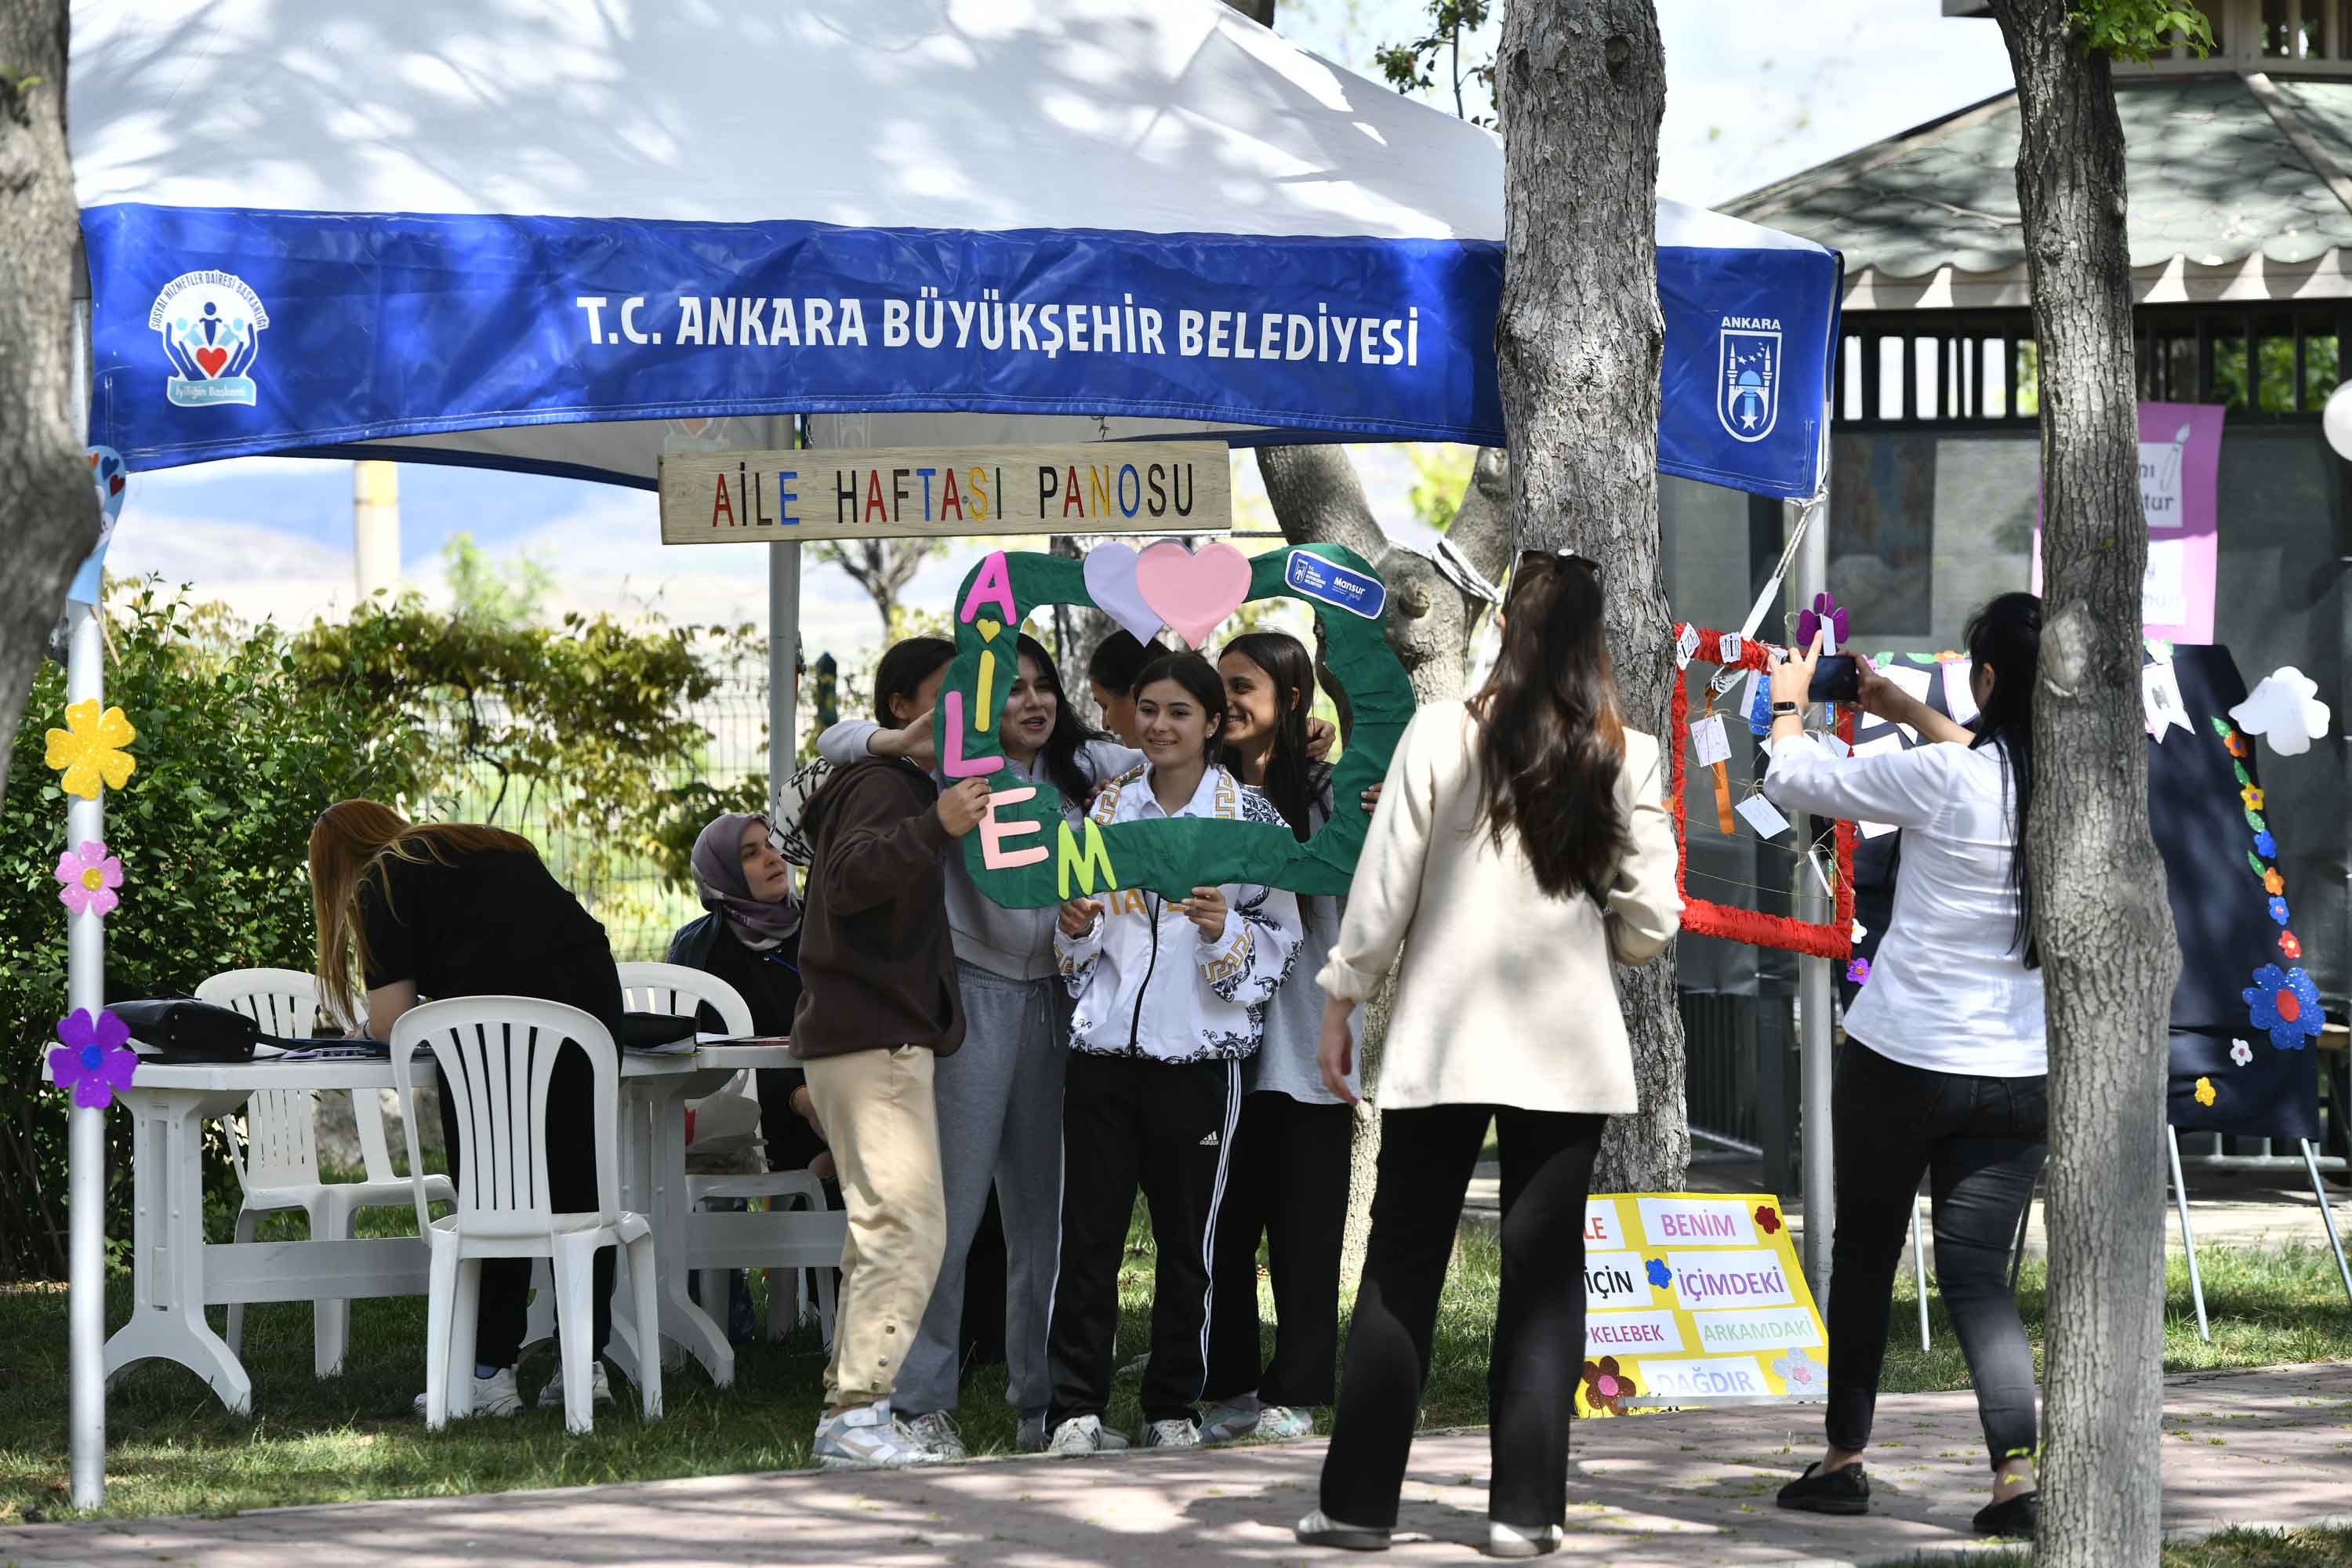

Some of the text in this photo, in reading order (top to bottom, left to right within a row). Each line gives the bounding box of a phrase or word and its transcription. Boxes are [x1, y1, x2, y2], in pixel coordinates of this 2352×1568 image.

[576, 285, 1418, 367] T.C. ANKARA BÜYÜKŞEHİR BELEDİYESİ
[1721, 316, 1782, 330] ANKARA
[712, 461, 1193, 528] AİLE HAFTASI PANOSU
[1334, 576, 1366, 596] Mansur
[1660, 1209, 1737, 1236] BENİM
[1677, 1265, 1785, 1302] İÇİMDEKİ
[1590, 1324, 1664, 1344] KELEBEK
[1704, 1316, 1816, 1341] ARKAMDAKİ
[1656, 1367, 1755, 1394] DAĞDIR
